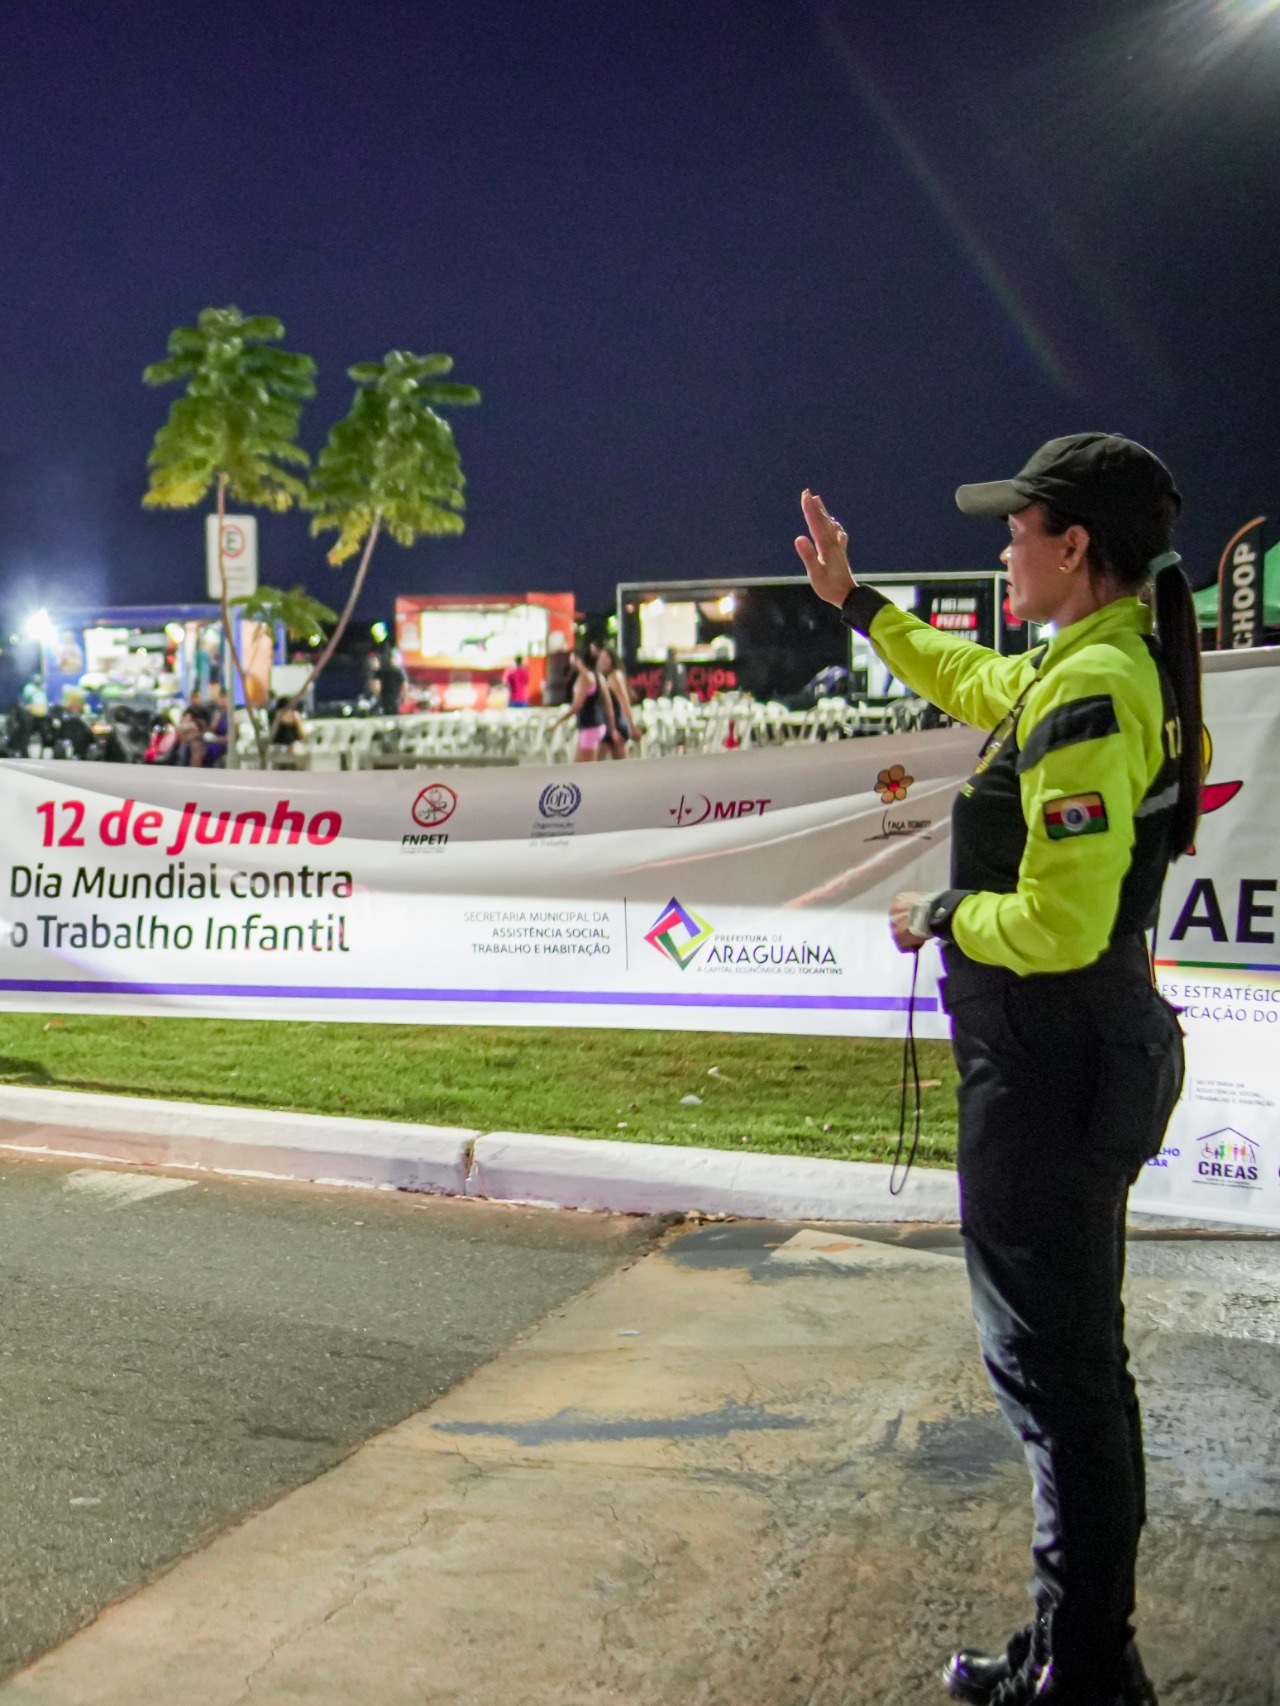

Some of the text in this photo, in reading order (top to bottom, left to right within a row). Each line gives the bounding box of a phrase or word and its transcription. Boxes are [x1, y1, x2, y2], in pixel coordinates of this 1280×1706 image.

[1232, 542, 1257, 649] CHOOP
[713, 799, 772, 819] MPT
[36, 798, 343, 857] 12 de Junho
[402, 834, 449, 846] FNPETI
[10, 862, 353, 900] Dia Mundial contra
[464, 911, 610, 923] SECRETARIA MUNICIPAL DA
[10, 914, 350, 952] o Trabalho Infantil
[492, 927, 610, 939] ASSISTÊNCIA SOCIAL,
[714, 934, 783, 943] PREFEITURA DE
[472, 942, 611, 957] TRABALHO E HABITAÇÃO
[706, 940, 837, 965] ARAGUAÍNA
[1253, 1009, 1278, 1022] DO
[1198, 1160, 1258, 1181] CREAS
